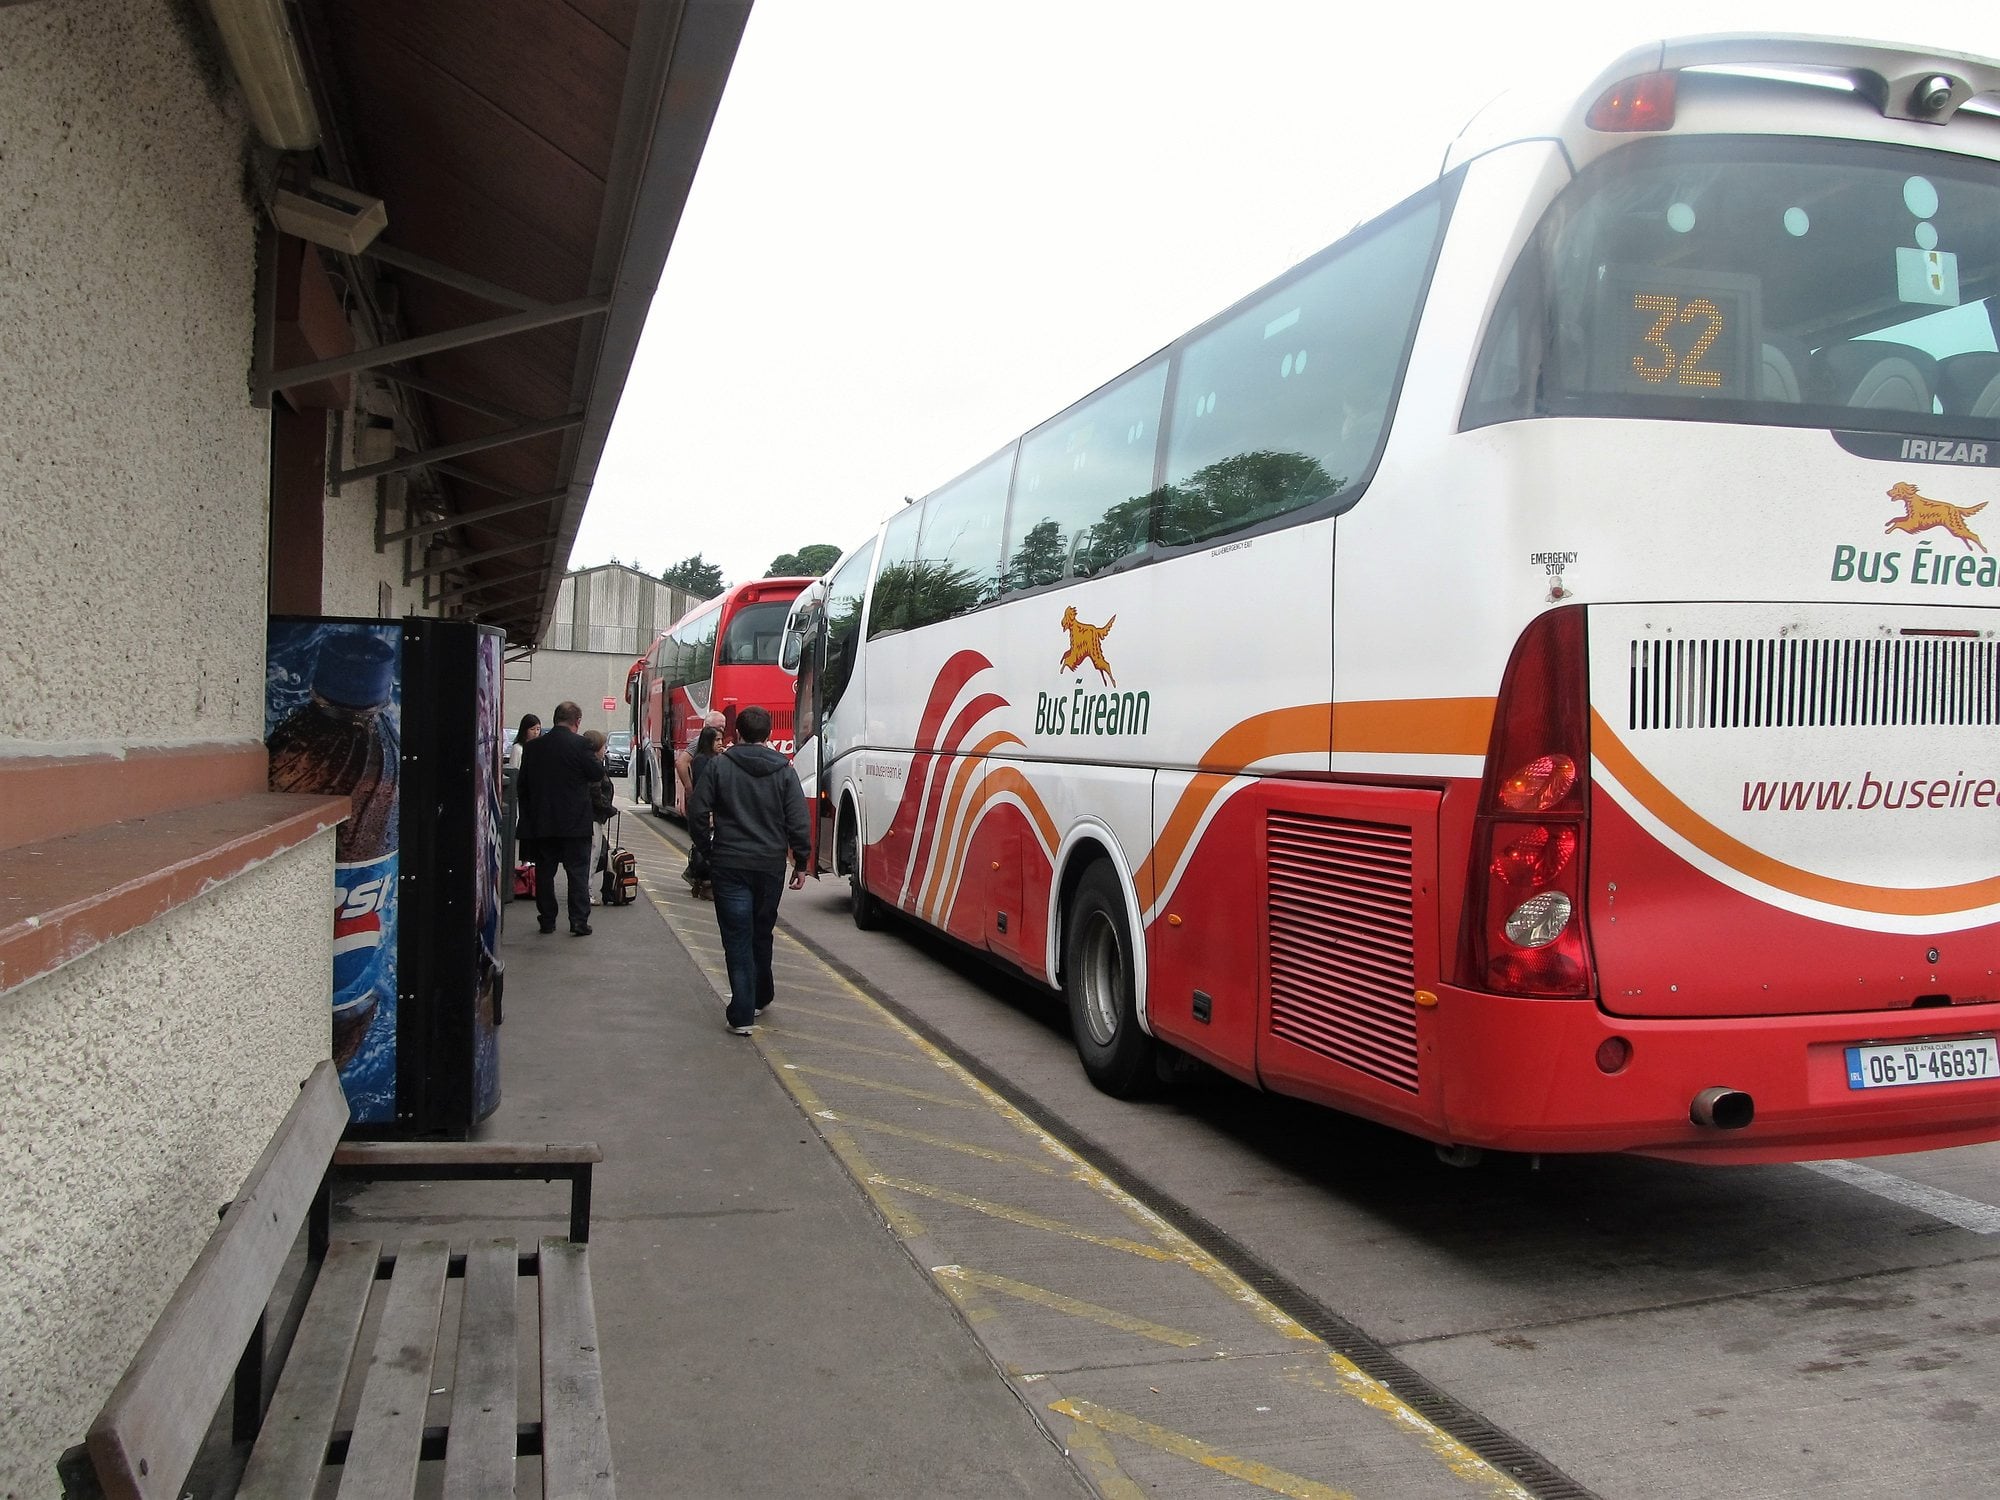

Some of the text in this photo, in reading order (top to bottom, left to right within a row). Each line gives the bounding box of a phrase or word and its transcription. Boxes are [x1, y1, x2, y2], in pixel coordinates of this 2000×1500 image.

[1633, 294, 1723, 386] 32
[1901, 439, 1988, 463] IRIZAR
[1531, 551, 1578, 565] EMERGENCY
[1546, 563, 1565, 575] STOP
[1831, 545, 1901, 584] Bus
[1035, 691, 1067, 735] Bus
[1742, 771, 2000, 811] www.buseire
[1850, 1072, 1862, 1081] IRL
[1870, 1048, 1988, 1083] 06-D-46837
